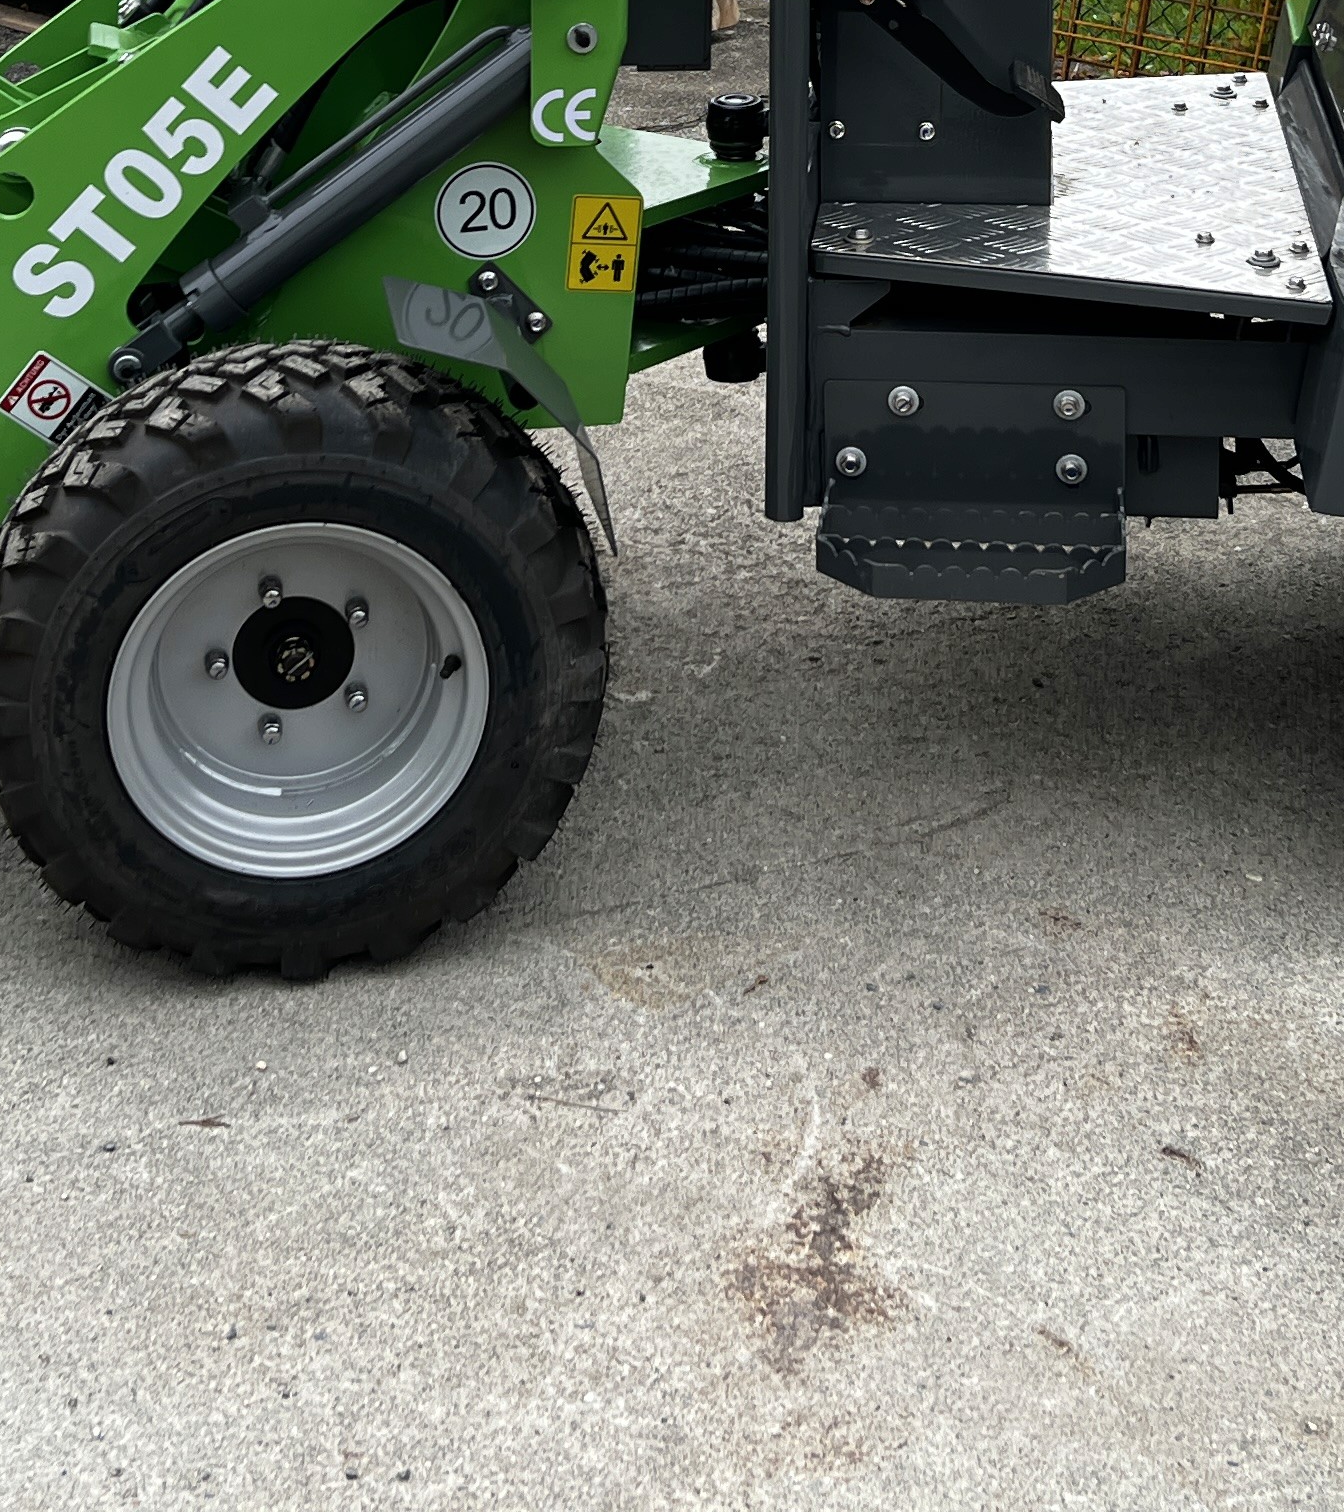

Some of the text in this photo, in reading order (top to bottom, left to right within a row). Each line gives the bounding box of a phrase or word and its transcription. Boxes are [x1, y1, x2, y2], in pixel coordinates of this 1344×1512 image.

[532, 88, 597, 143] CE
[458, 187, 518, 235] 20
[17, 359, 45, 395] ACHTUNG
